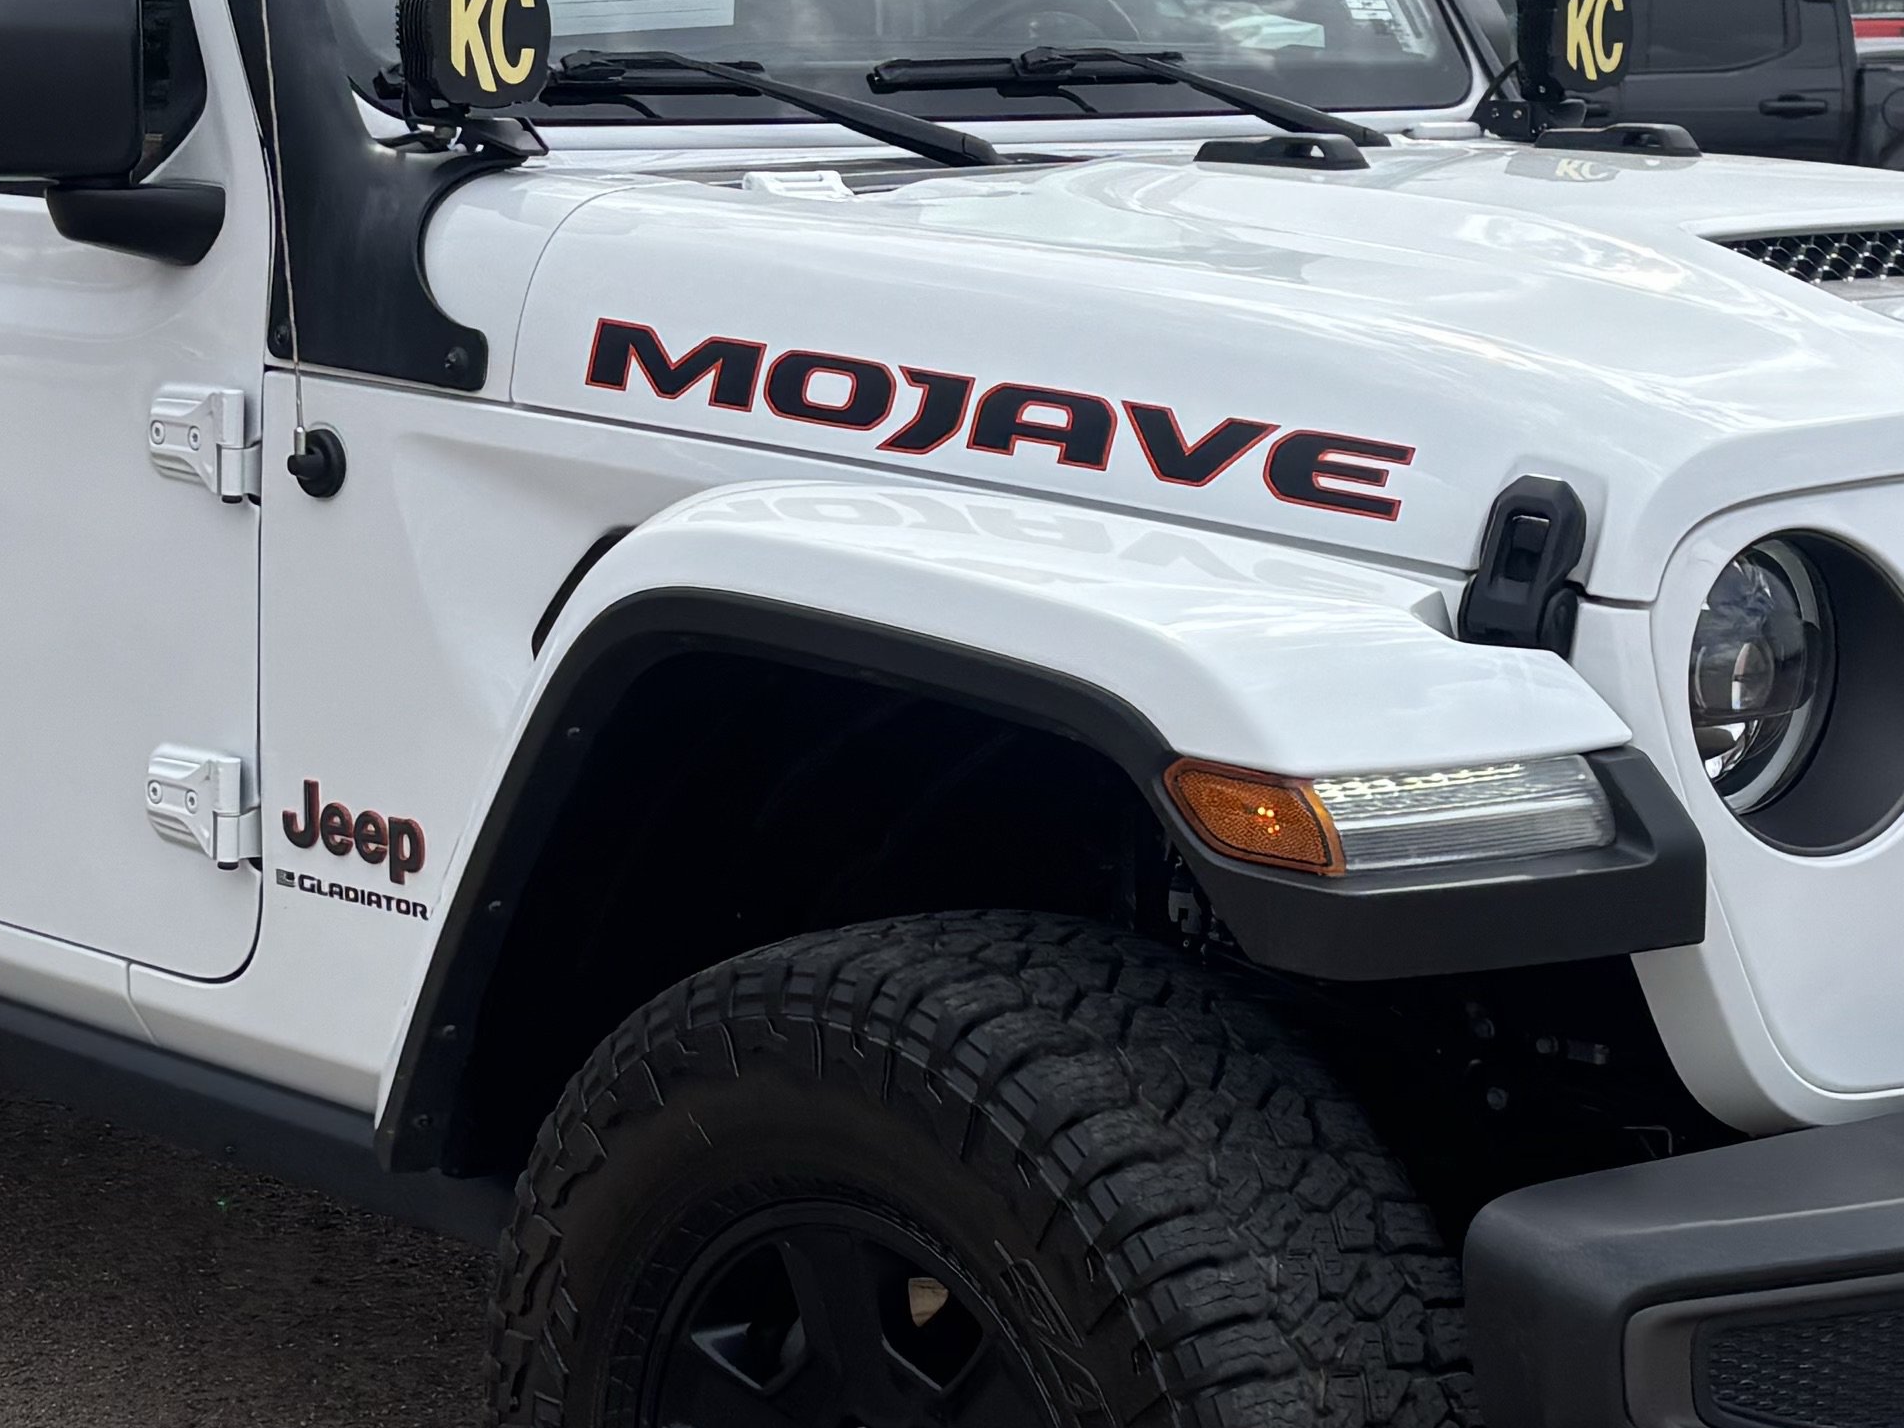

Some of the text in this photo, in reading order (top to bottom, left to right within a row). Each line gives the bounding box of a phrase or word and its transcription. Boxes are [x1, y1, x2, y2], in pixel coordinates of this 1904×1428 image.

[584, 316, 1416, 523] MOJAVE
[282, 778, 426, 886] Jeep
[298, 873, 430, 921] GLADIATOR
